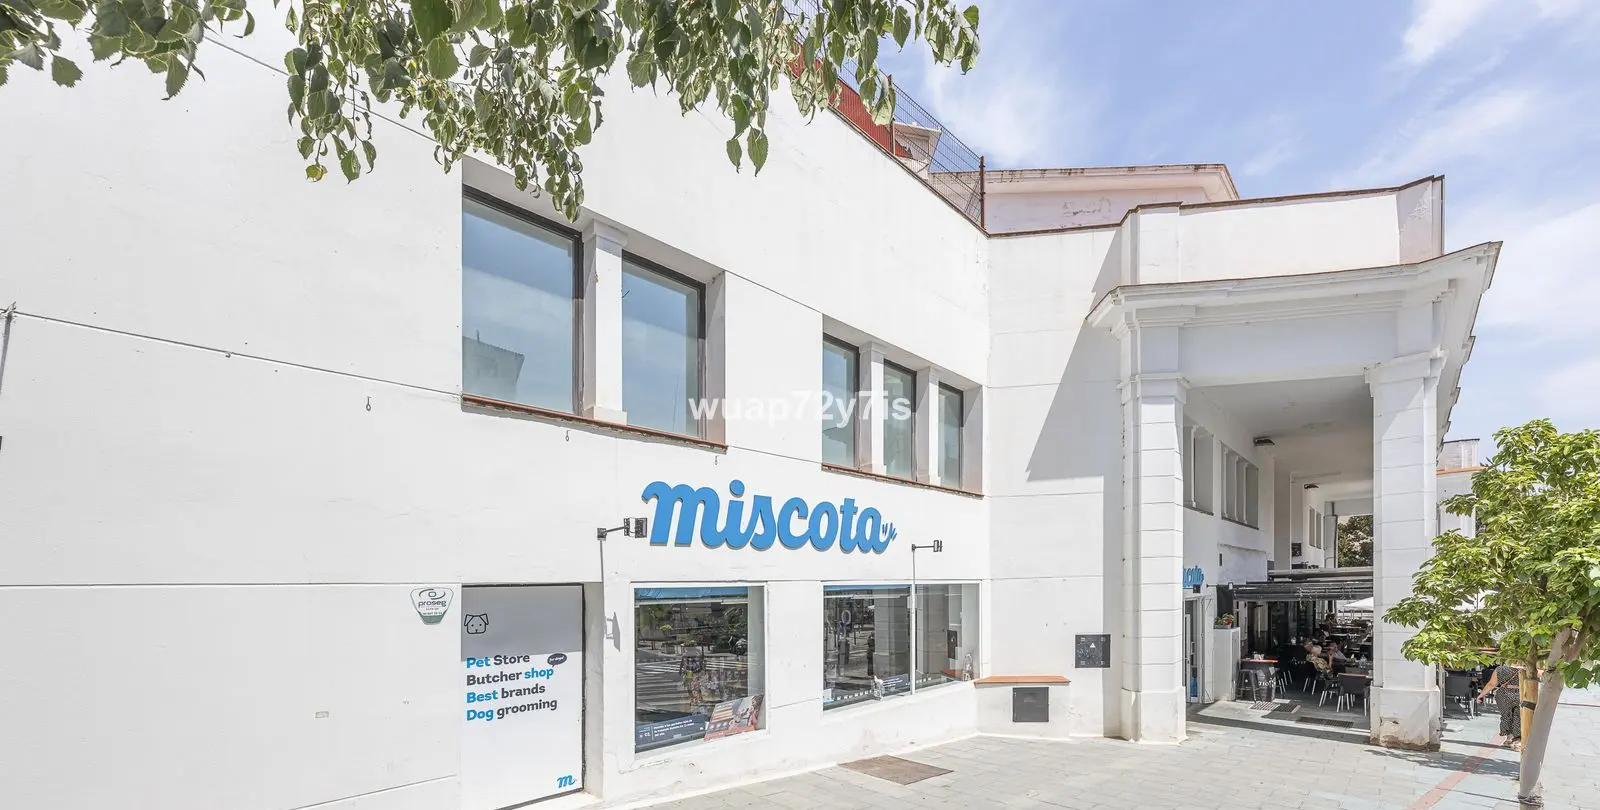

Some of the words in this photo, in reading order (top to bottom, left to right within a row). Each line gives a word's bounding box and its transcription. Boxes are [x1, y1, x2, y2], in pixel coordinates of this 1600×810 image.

[642, 480, 897, 554] miscota
[466, 657, 491, 668] Pet
[493, 655, 530, 666] Store
[466, 671, 522, 686] Butcher
[524, 668, 554, 679] shop
[466, 690, 498, 703] Best
[501, 683, 546, 699] brands
[466, 709, 494, 721] Dog
[496, 699, 558, 720] grooming
[557, 774, 576, 788] m
